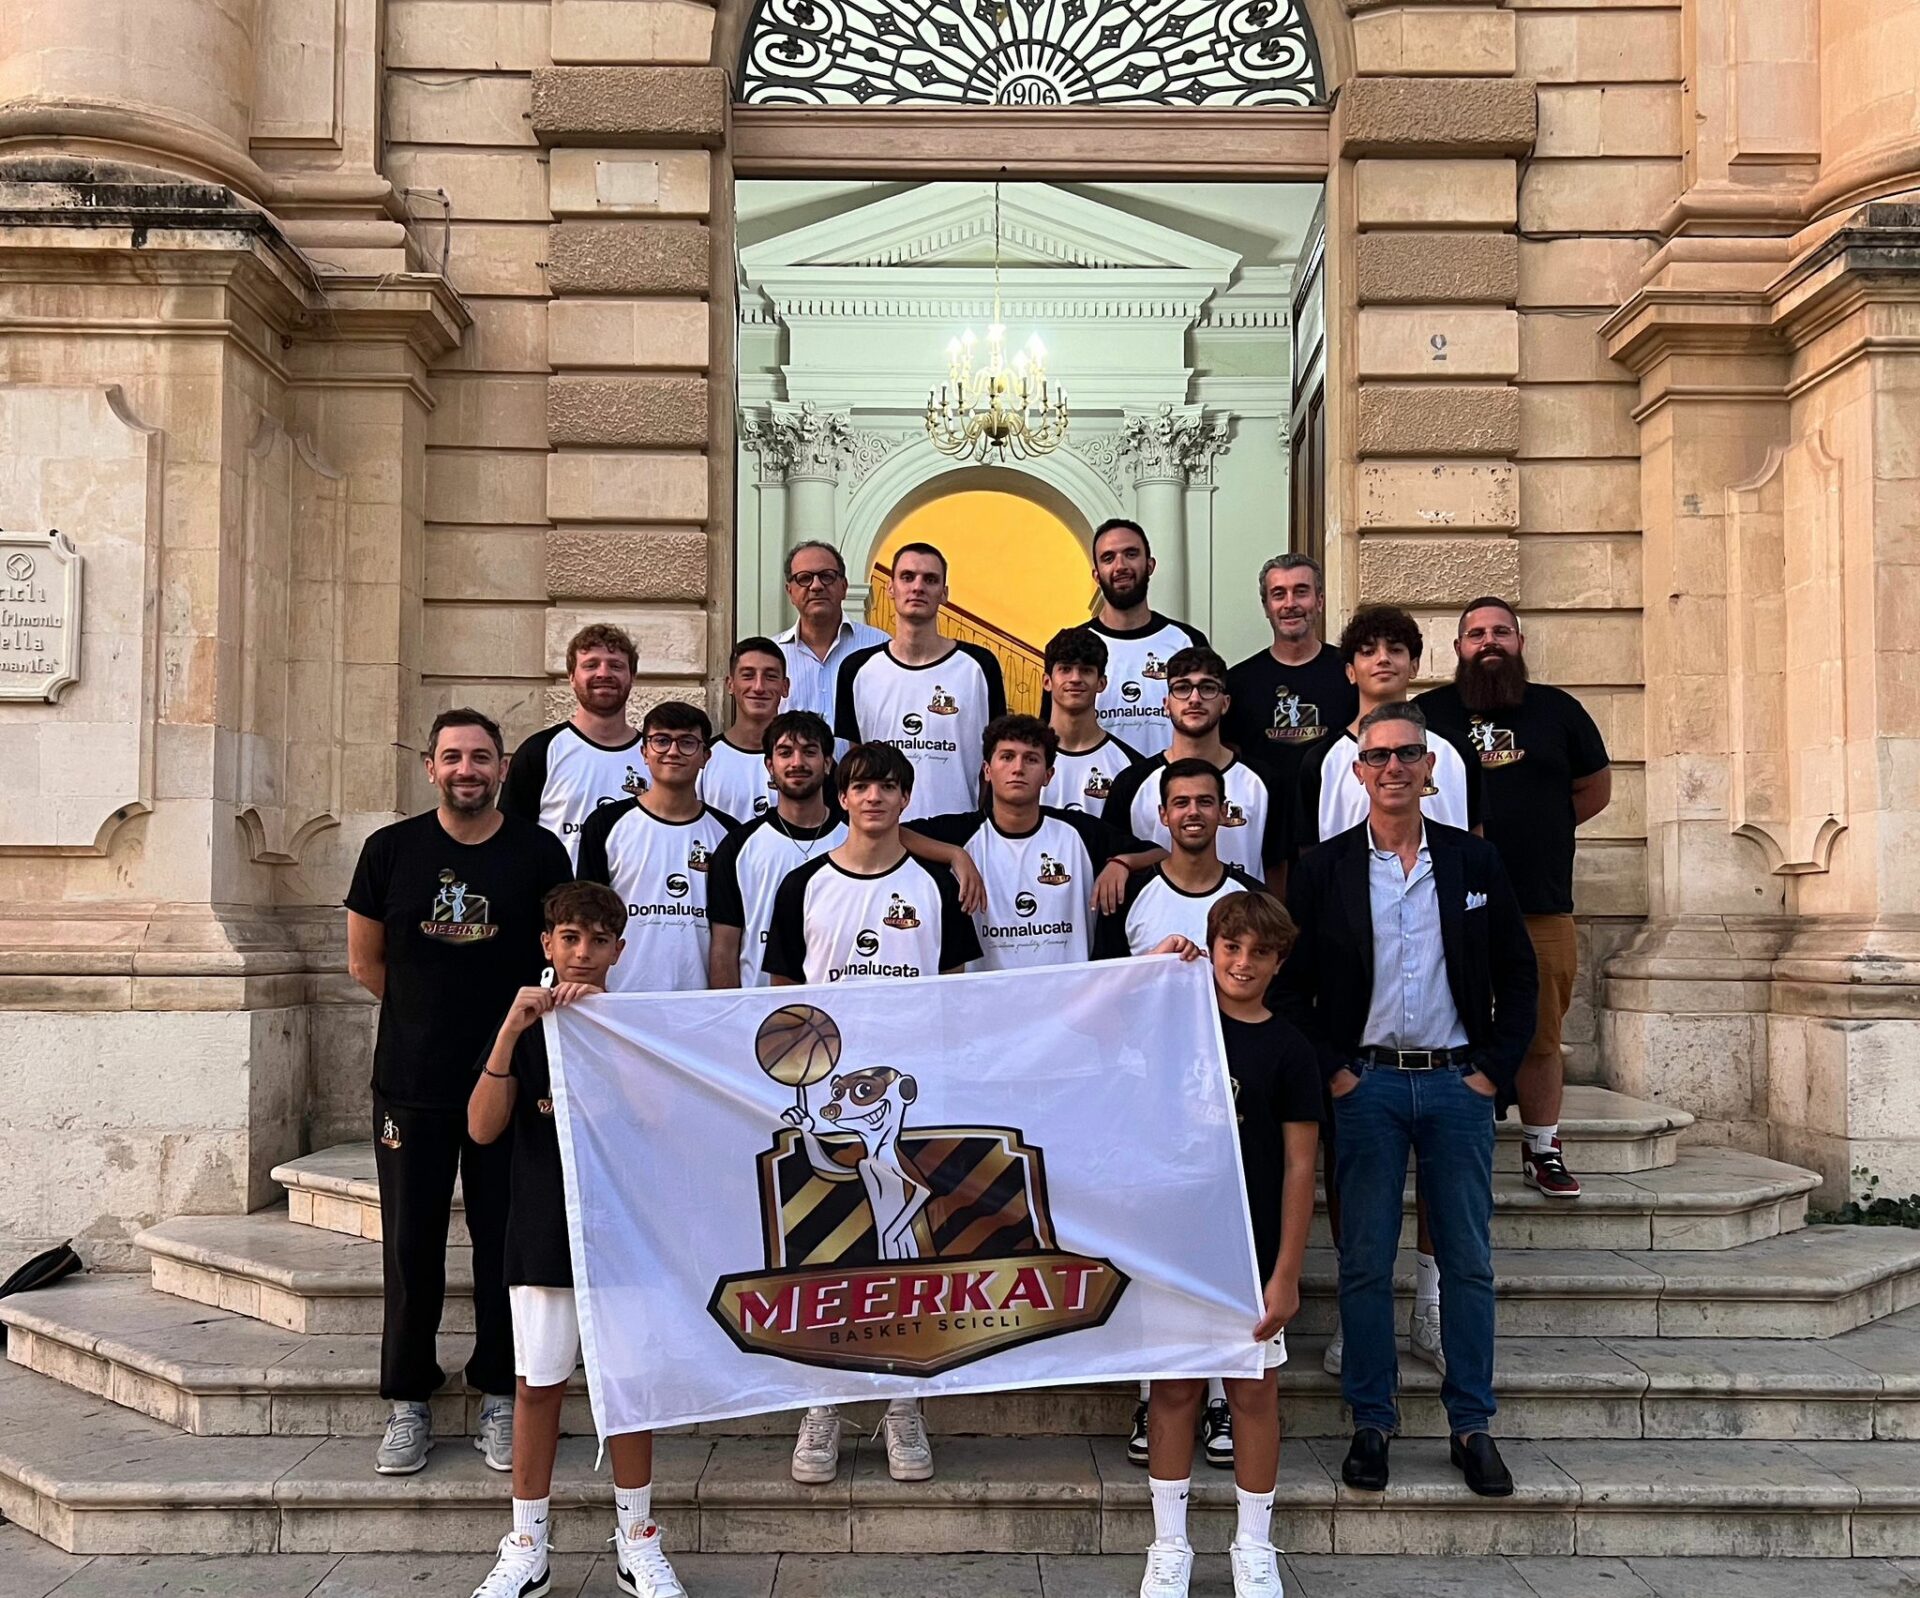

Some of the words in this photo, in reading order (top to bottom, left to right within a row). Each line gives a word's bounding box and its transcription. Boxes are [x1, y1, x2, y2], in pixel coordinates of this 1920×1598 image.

[1006, 82, 1055, 105] 1906
[0, 580, 46, 603] cicli
[0, 609, 63, 628] trimonio
[0, 630, 44, 651] ella
[0, 656, 59, 674] manità
[1479, 750, 1523, 762] ERKAT
[628, 902, 707, 918] Donnaluca
[982, 921, 1073, 937] Donnalucata
[735, 1266, 1104, 1334] MEERKAT
[829, 1322, 923, 1345] BASKET
[939, 1315, 1021, 1332] SCICLI
